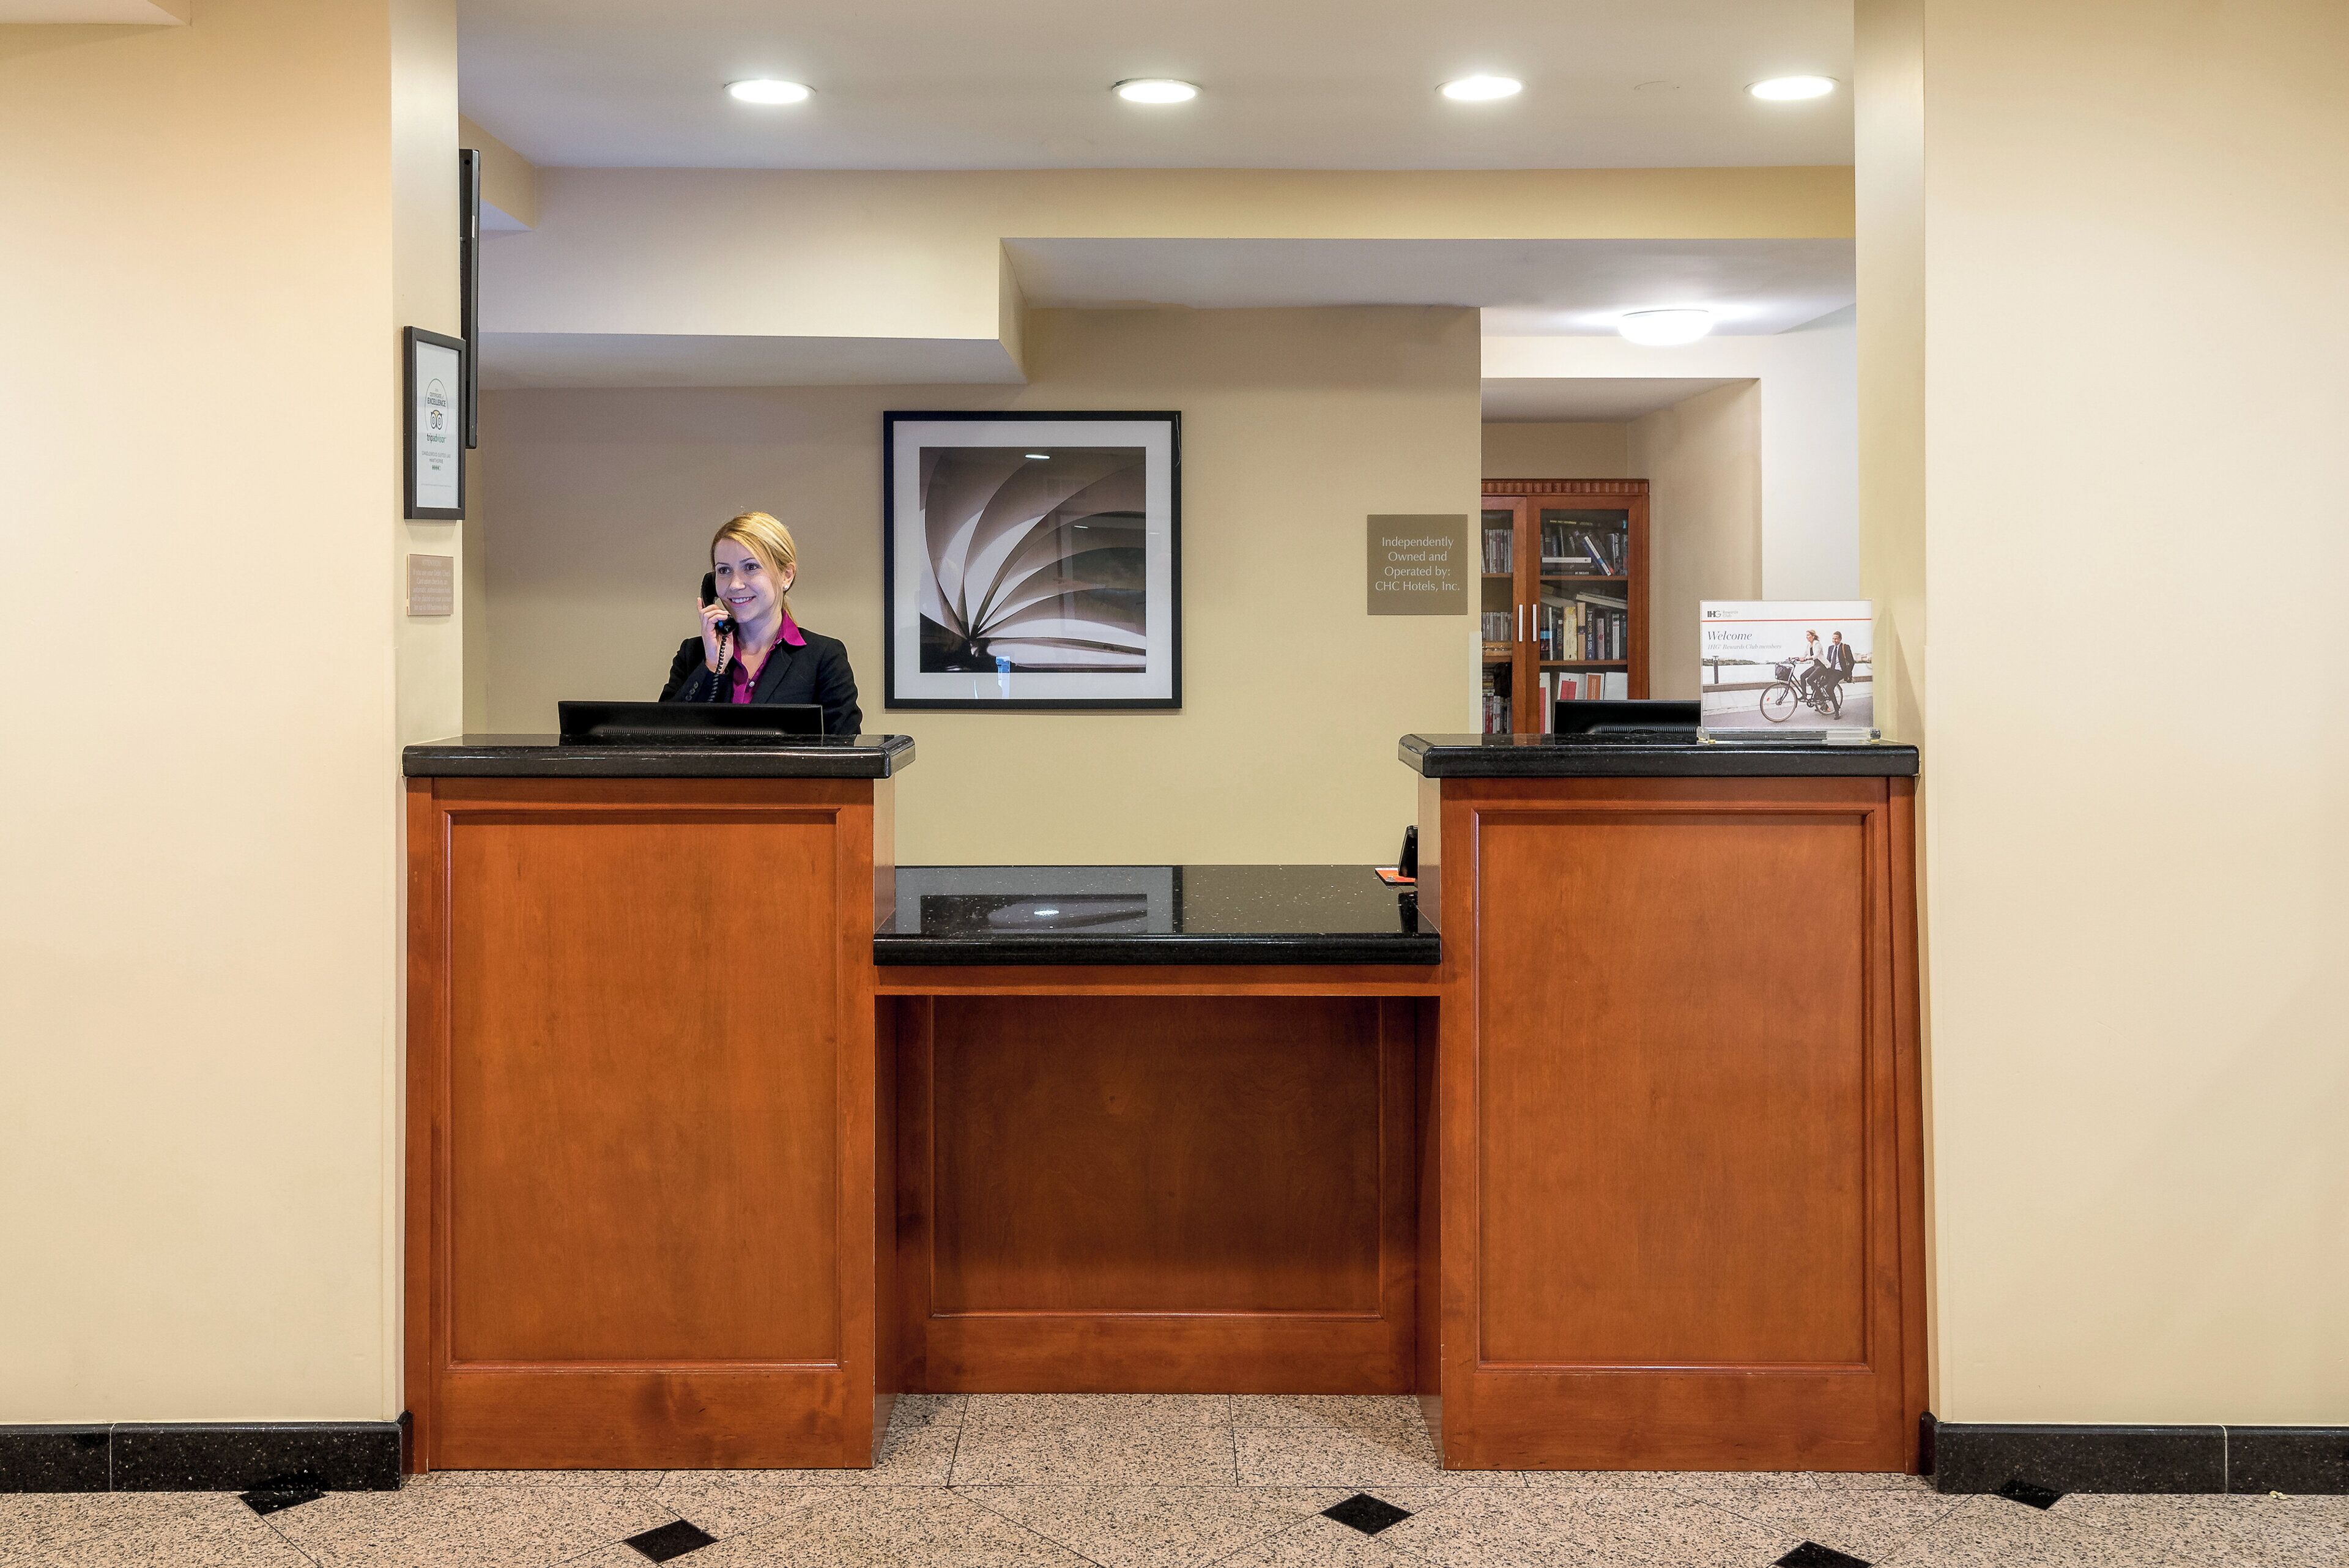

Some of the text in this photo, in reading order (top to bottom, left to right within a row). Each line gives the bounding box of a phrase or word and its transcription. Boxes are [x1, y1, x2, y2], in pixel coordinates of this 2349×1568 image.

[427, 397, 446, 407] EXCELLENCE
[426, 433, 446, 444] tripadvisor
[1382, 536, 1454, 550] Independently
[1388, 551, 1447, 562] Owned and
[1384, 566, 1451, 579] Operated by:
[1375, 581, 1460, 592] CHC Hotels, Inc.
[1708, 631, 1753, 641] Welcome
